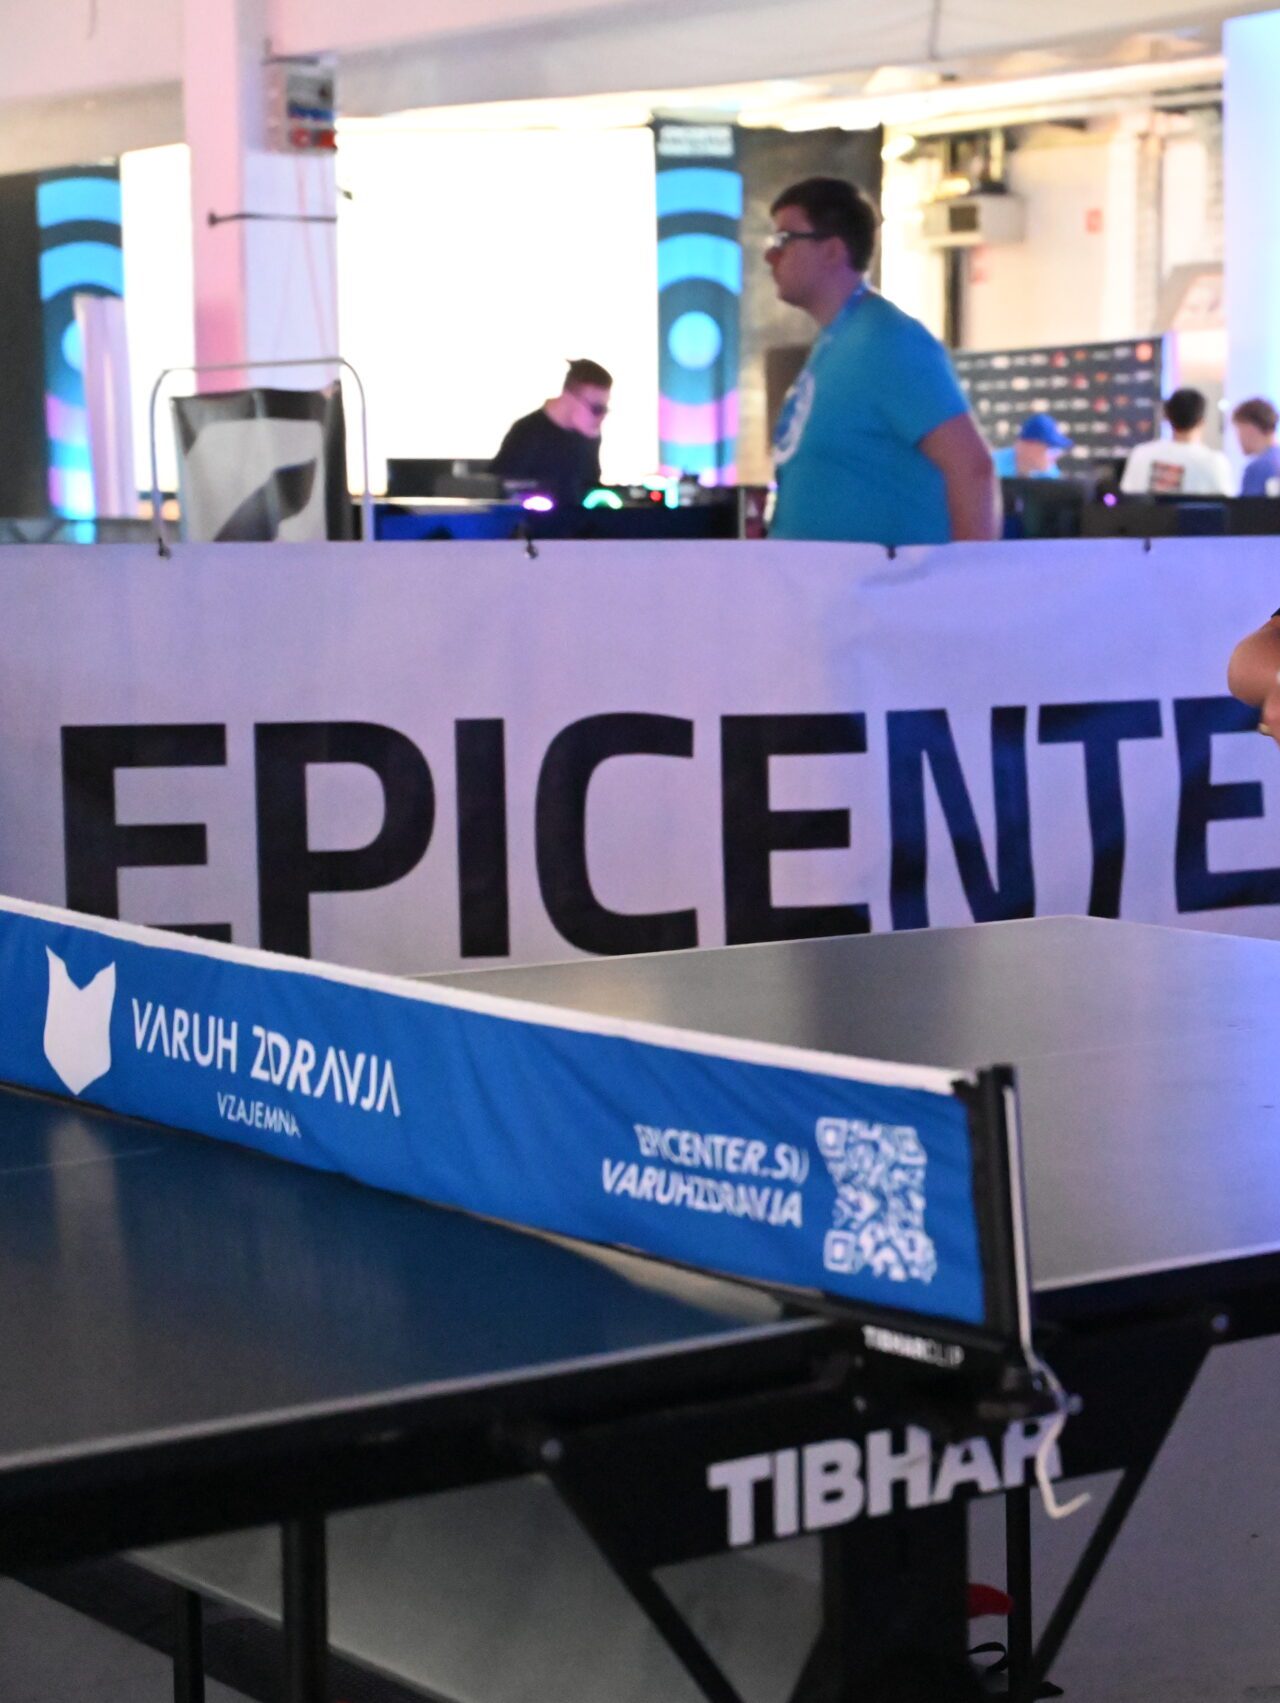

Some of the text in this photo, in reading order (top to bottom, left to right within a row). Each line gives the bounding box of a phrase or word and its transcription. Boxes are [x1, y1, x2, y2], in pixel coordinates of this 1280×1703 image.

[132, 998, 401, 1118] VARUH ZDRAVJA
[217, 1091, 302, 1138] VZAJEMNA
[706, 1411, 1063, 1548] TIBHAR
